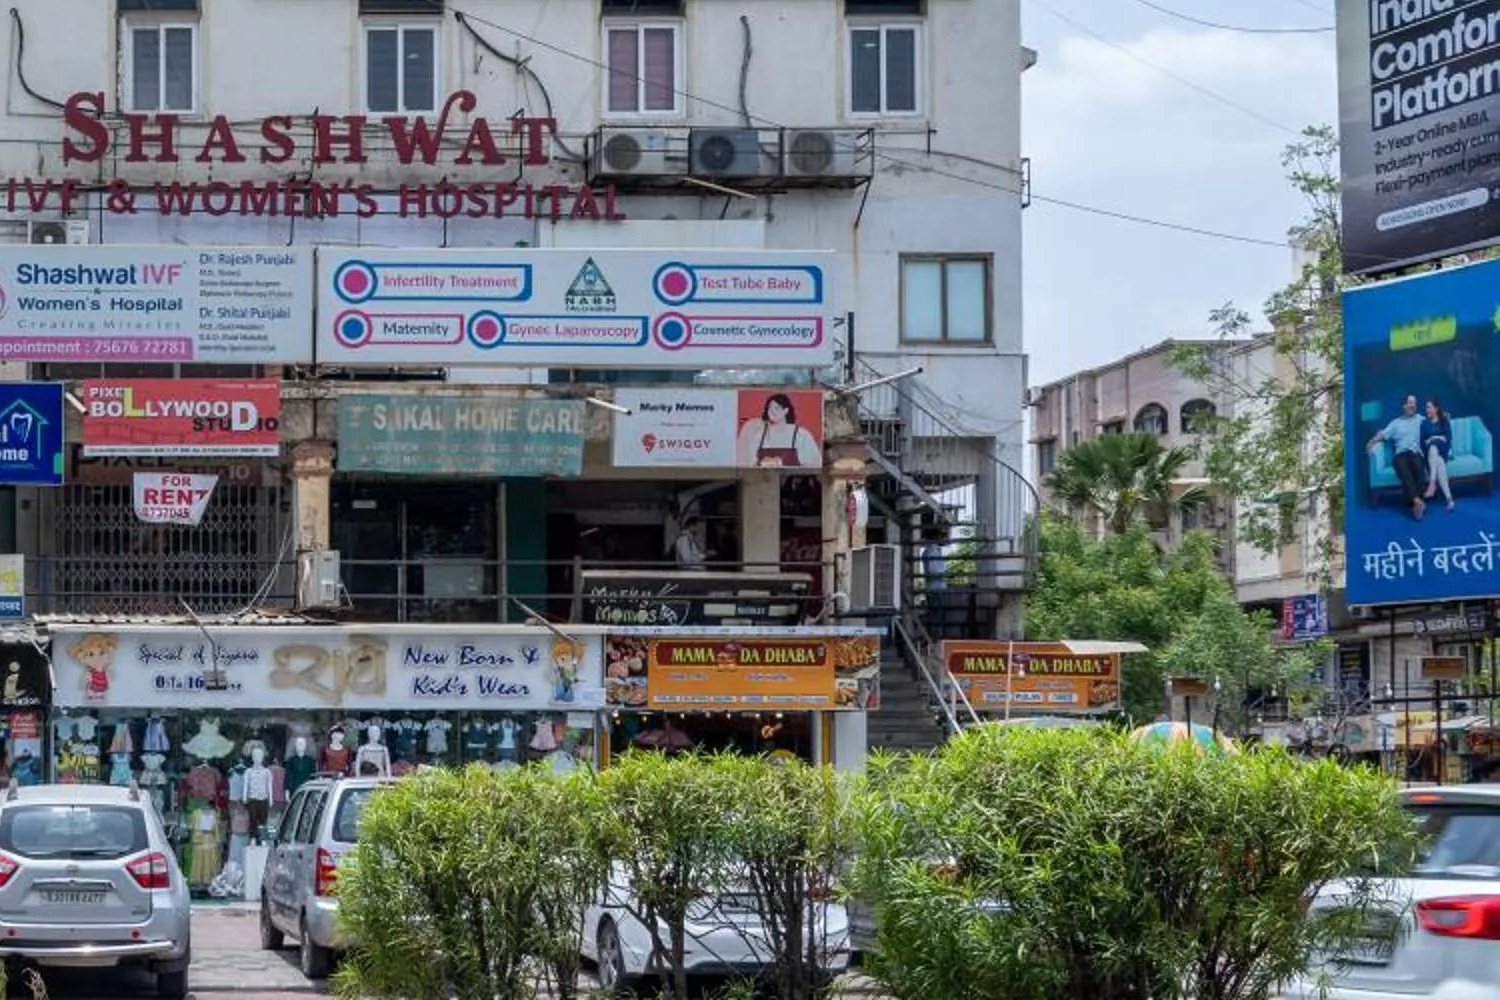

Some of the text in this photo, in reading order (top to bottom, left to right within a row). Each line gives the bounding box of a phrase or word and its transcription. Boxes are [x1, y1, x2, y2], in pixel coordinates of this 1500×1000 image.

[63, 89, 558, 166] SHASHWAT
[6, 178, 627, 223] IVF & WOMEN'S HOSPITAL
[17, 262, 182, 285] Shashwat IVF
[382, 275, 518, 289] Infertility Treatment
[702, 277, 802, 292] Test Tube Baby
[17, 297, 183, 314] Women's Hospital
[383, 321, 815, 339] Maternity Gynec Laparoscopy Cosmetic Gynecology
[455, 405, 520, 431] HOME
[658, 438, 712, 449] SWIGGY
[161, 475, 192, 486] FOR
[143, 487, 209, 505] RENT
[1362, 531, 1497, 581] महीने बदलें
[137, 643, 184, 664] Special
[403, 644, 452, 667] New
[457, 645, 517, 668] Born
[671, 647, 816, 664] MAMA DA DHABA
[963, 656, 1102, 673] MAMA DA DHABA
[412, 674, 468, 696] Kid's
[477, 674, 531, 696] Wear
